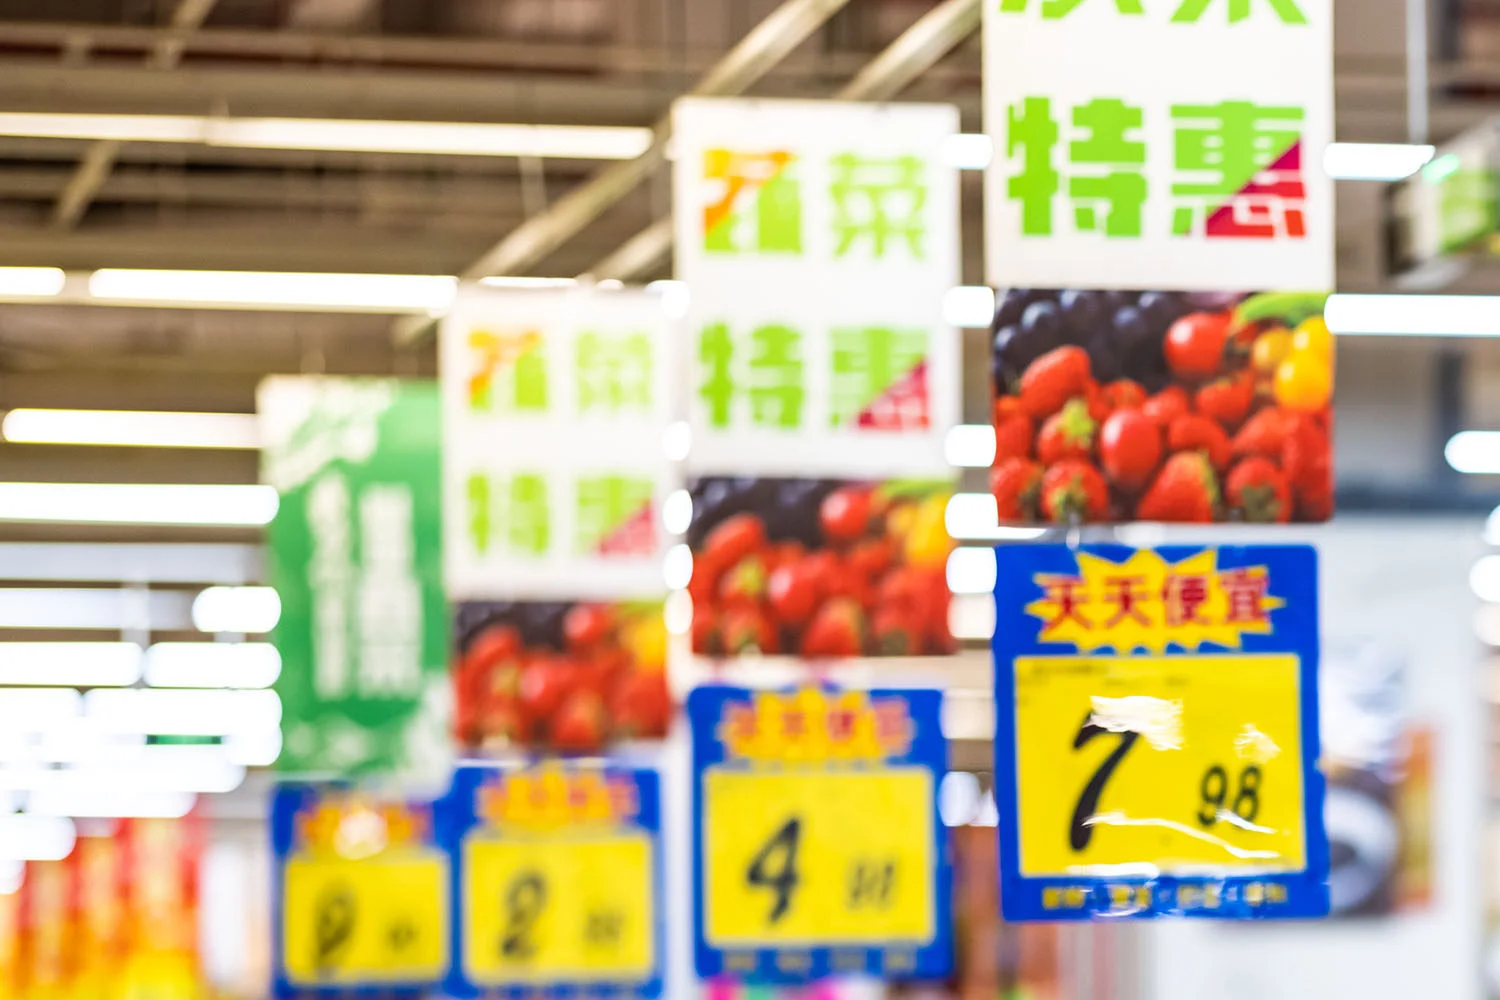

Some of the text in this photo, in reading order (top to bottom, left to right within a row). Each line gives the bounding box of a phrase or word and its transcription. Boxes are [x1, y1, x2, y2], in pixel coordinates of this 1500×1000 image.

[1007, 97, 1306, 238] 特惠
[1043, 567, 1268, 630] 天天便宜
[1069, 708, 1262, 853] 7 98
[744, 815, 802, 926] 4
